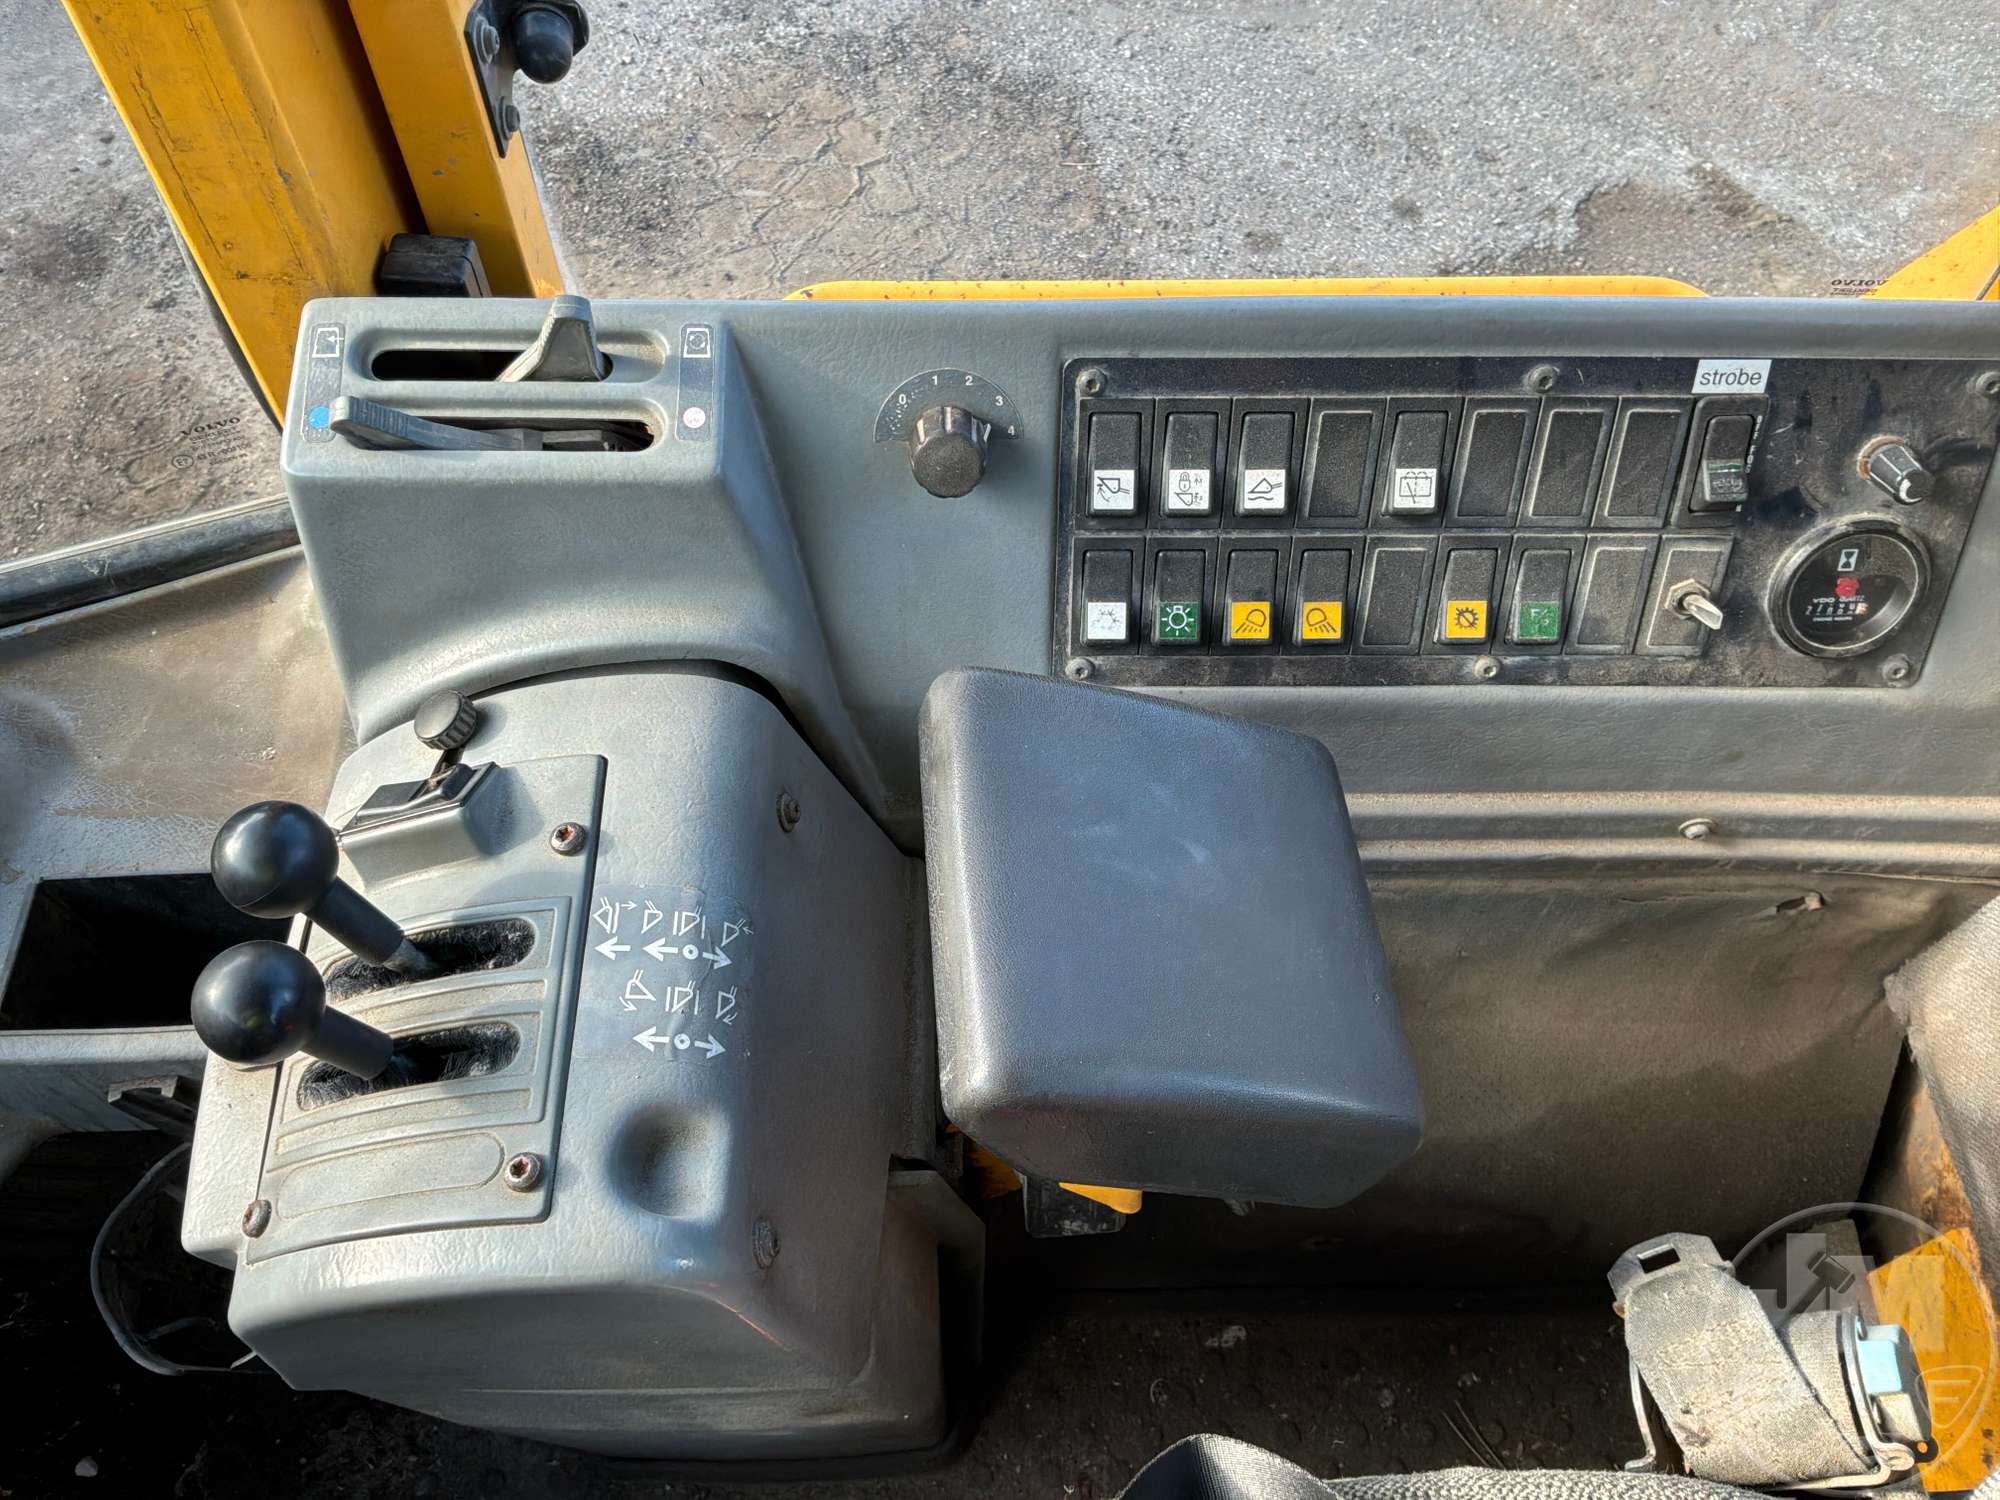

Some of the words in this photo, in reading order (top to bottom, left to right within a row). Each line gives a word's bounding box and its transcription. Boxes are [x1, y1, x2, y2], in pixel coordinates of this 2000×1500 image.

[931, 375, 938, 386] 1
[965, 375, 973, 386] 2
[1699, 368, 1762, 386] strobe
[898, 393, 907, 405] 0
[995, 395, 1004, 407] 3
[180, 416, 240, 436] VOLVO
[1007, 425, 1016, 436] 4
